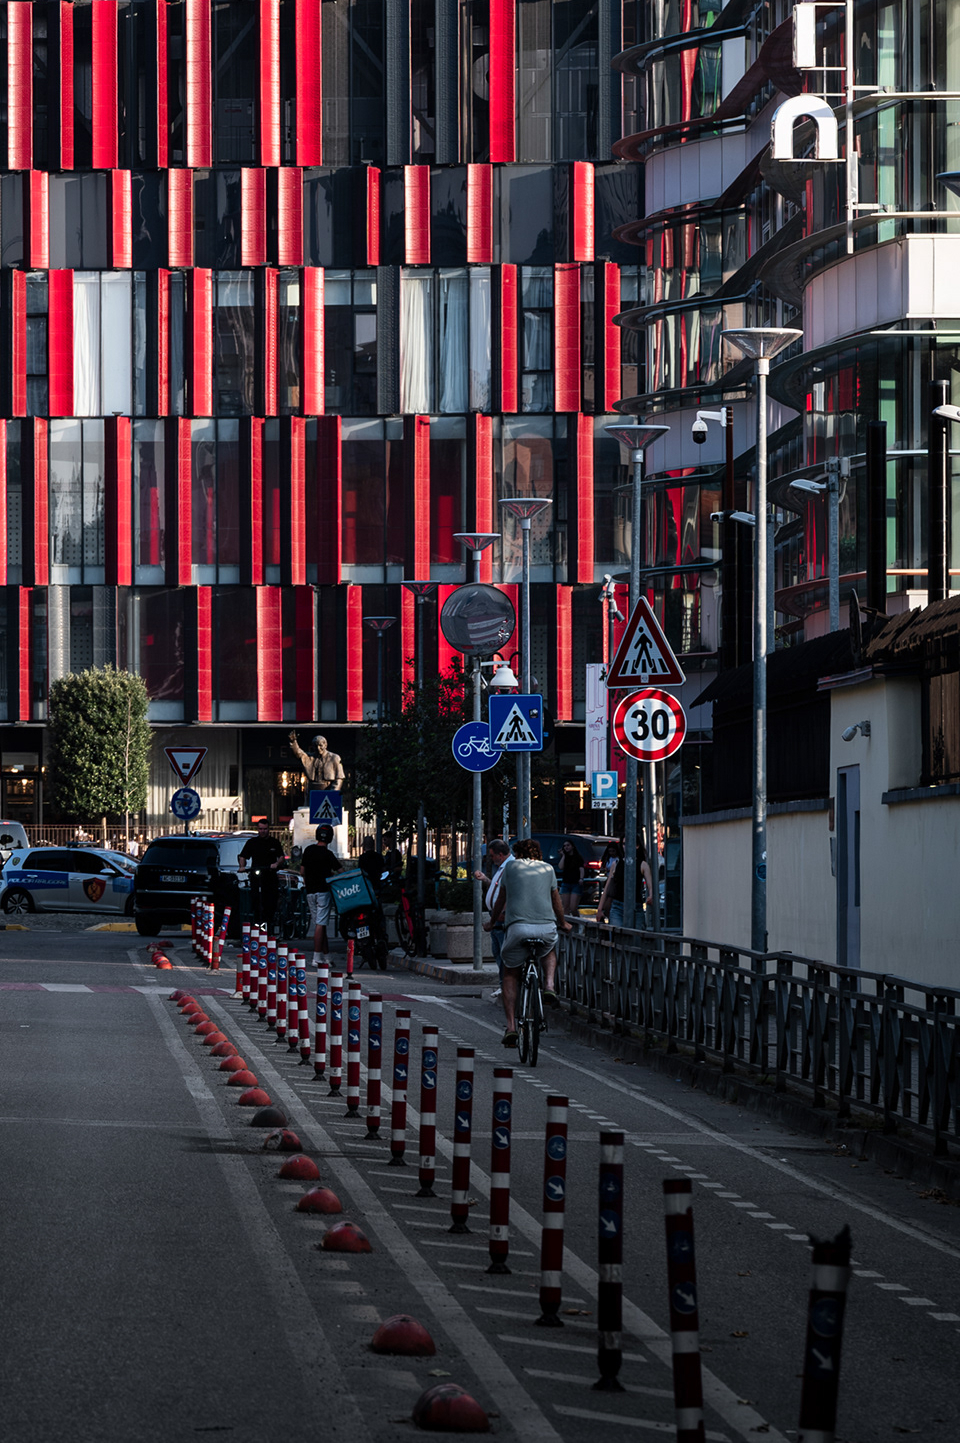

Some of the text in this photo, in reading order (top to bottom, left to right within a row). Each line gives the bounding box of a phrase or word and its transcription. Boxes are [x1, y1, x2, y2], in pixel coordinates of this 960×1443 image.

[631, 709, 669, 741] 30
[596, 773, 614, 797] P
[336, 883, 361, 899] Wolt
